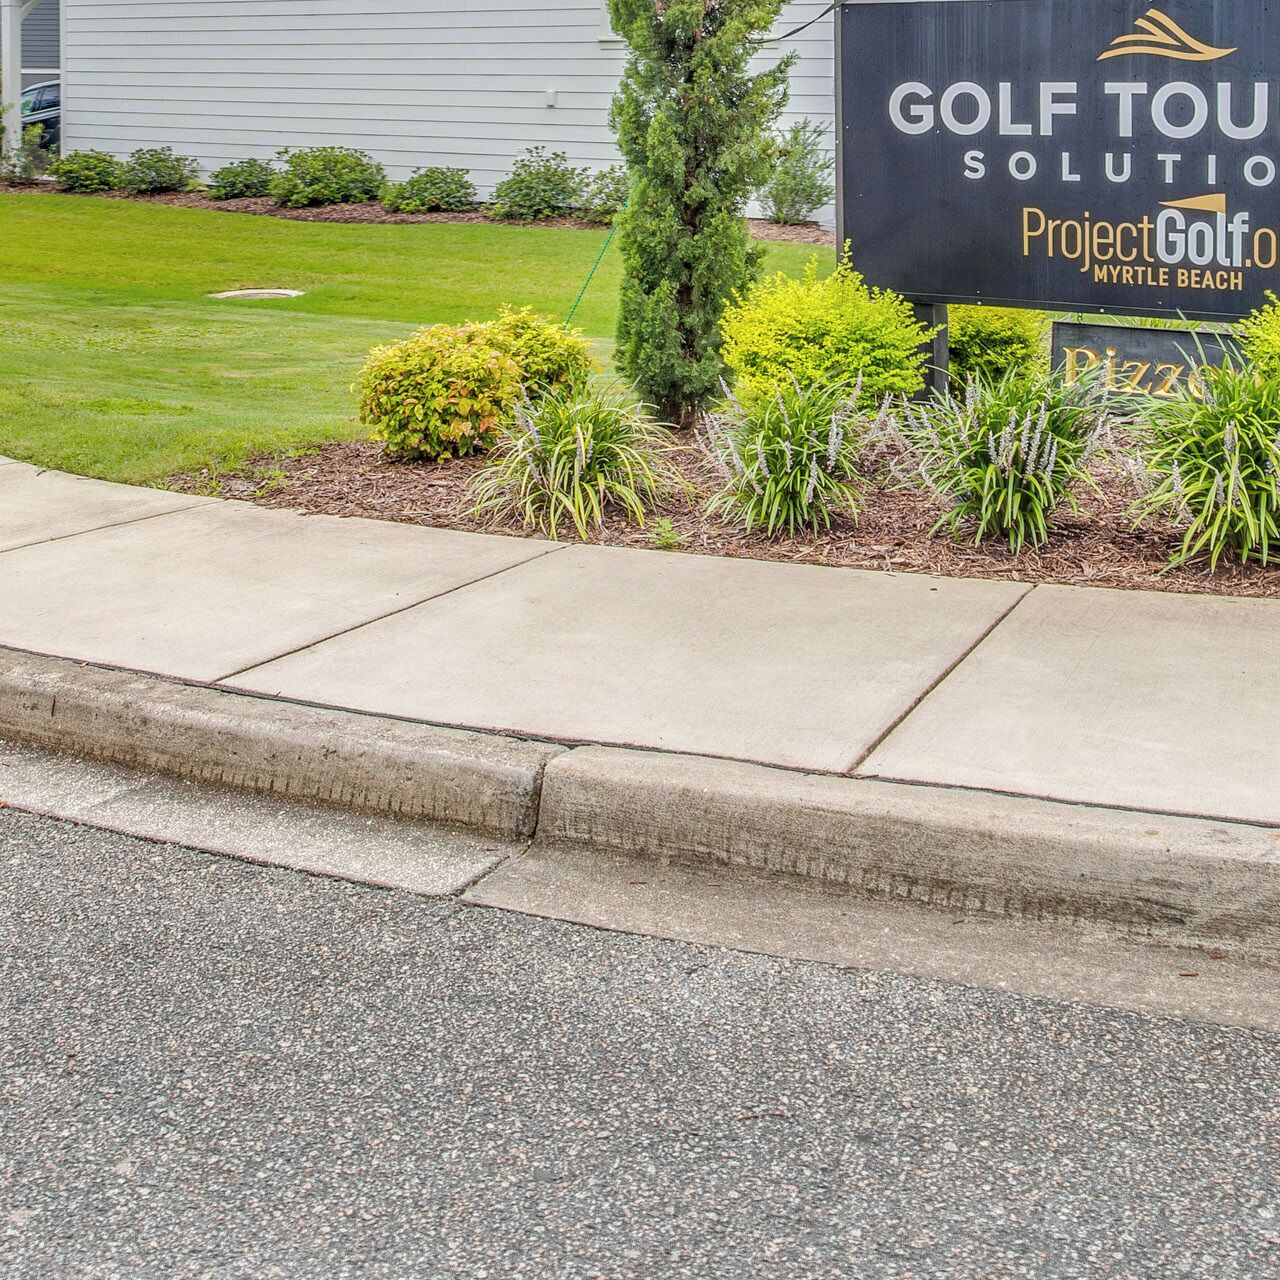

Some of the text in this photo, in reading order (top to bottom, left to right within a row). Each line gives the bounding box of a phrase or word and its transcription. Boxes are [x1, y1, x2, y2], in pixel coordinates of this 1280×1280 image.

[888, 81, 1077, 136] GOLF
[1093, 263, 1243, 291] MYRTLE BEACH
